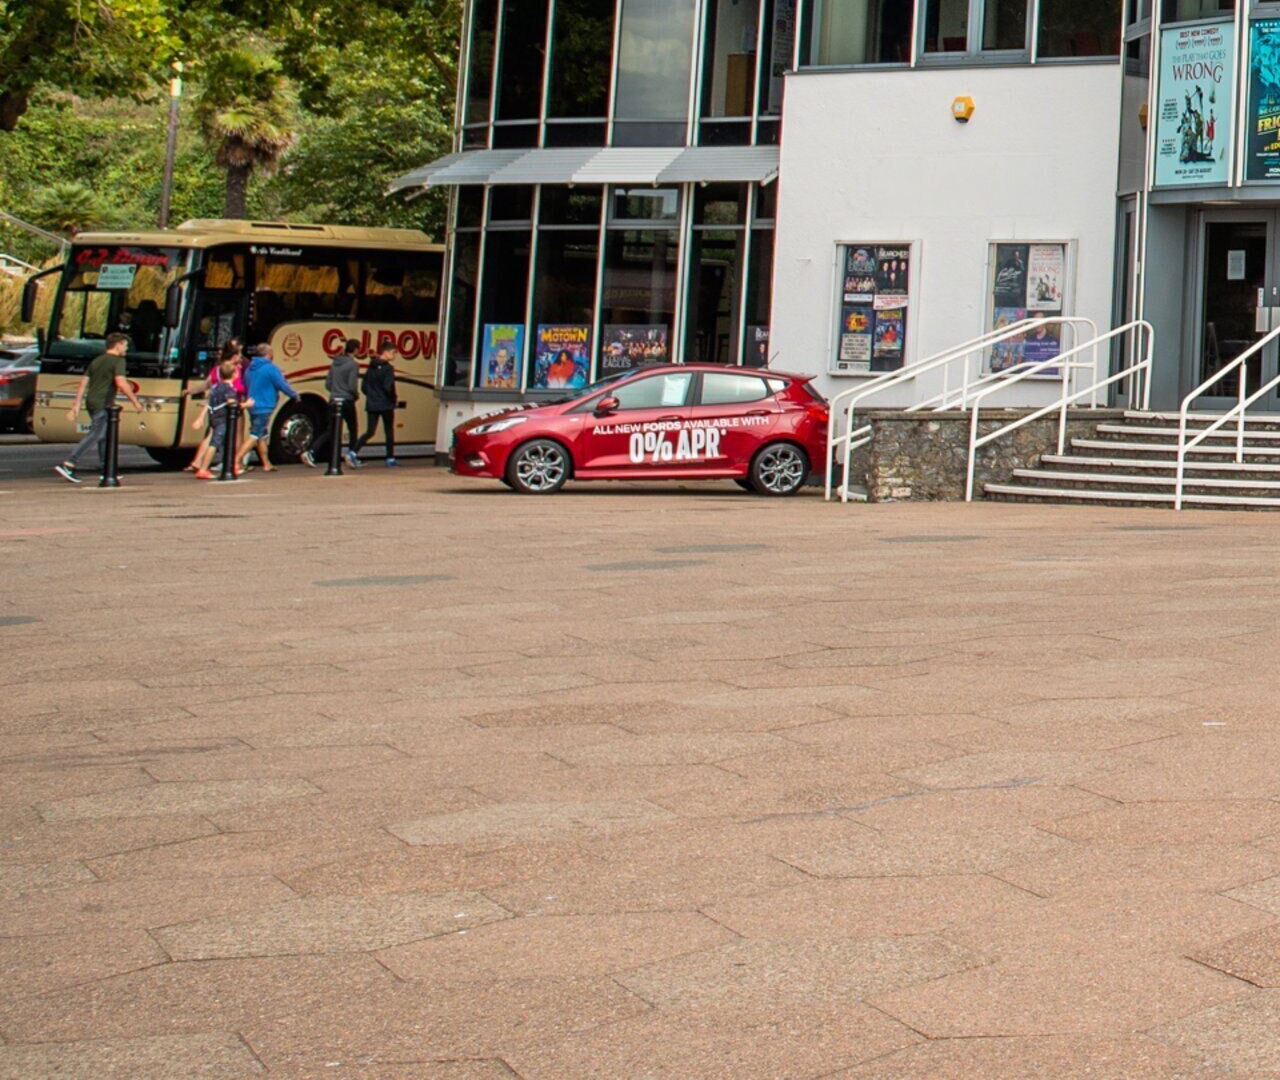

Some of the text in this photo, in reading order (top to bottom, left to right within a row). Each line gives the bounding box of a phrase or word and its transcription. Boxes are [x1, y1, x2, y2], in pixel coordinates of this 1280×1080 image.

[1173, 62, 1223, 83] WRONG
[542, 327, 588, 342] MOTOWN
[593, 417, 770, 435] ALL NEW FORDS AVAILABLE WITH
[629, 430, 673, 463] 0%
